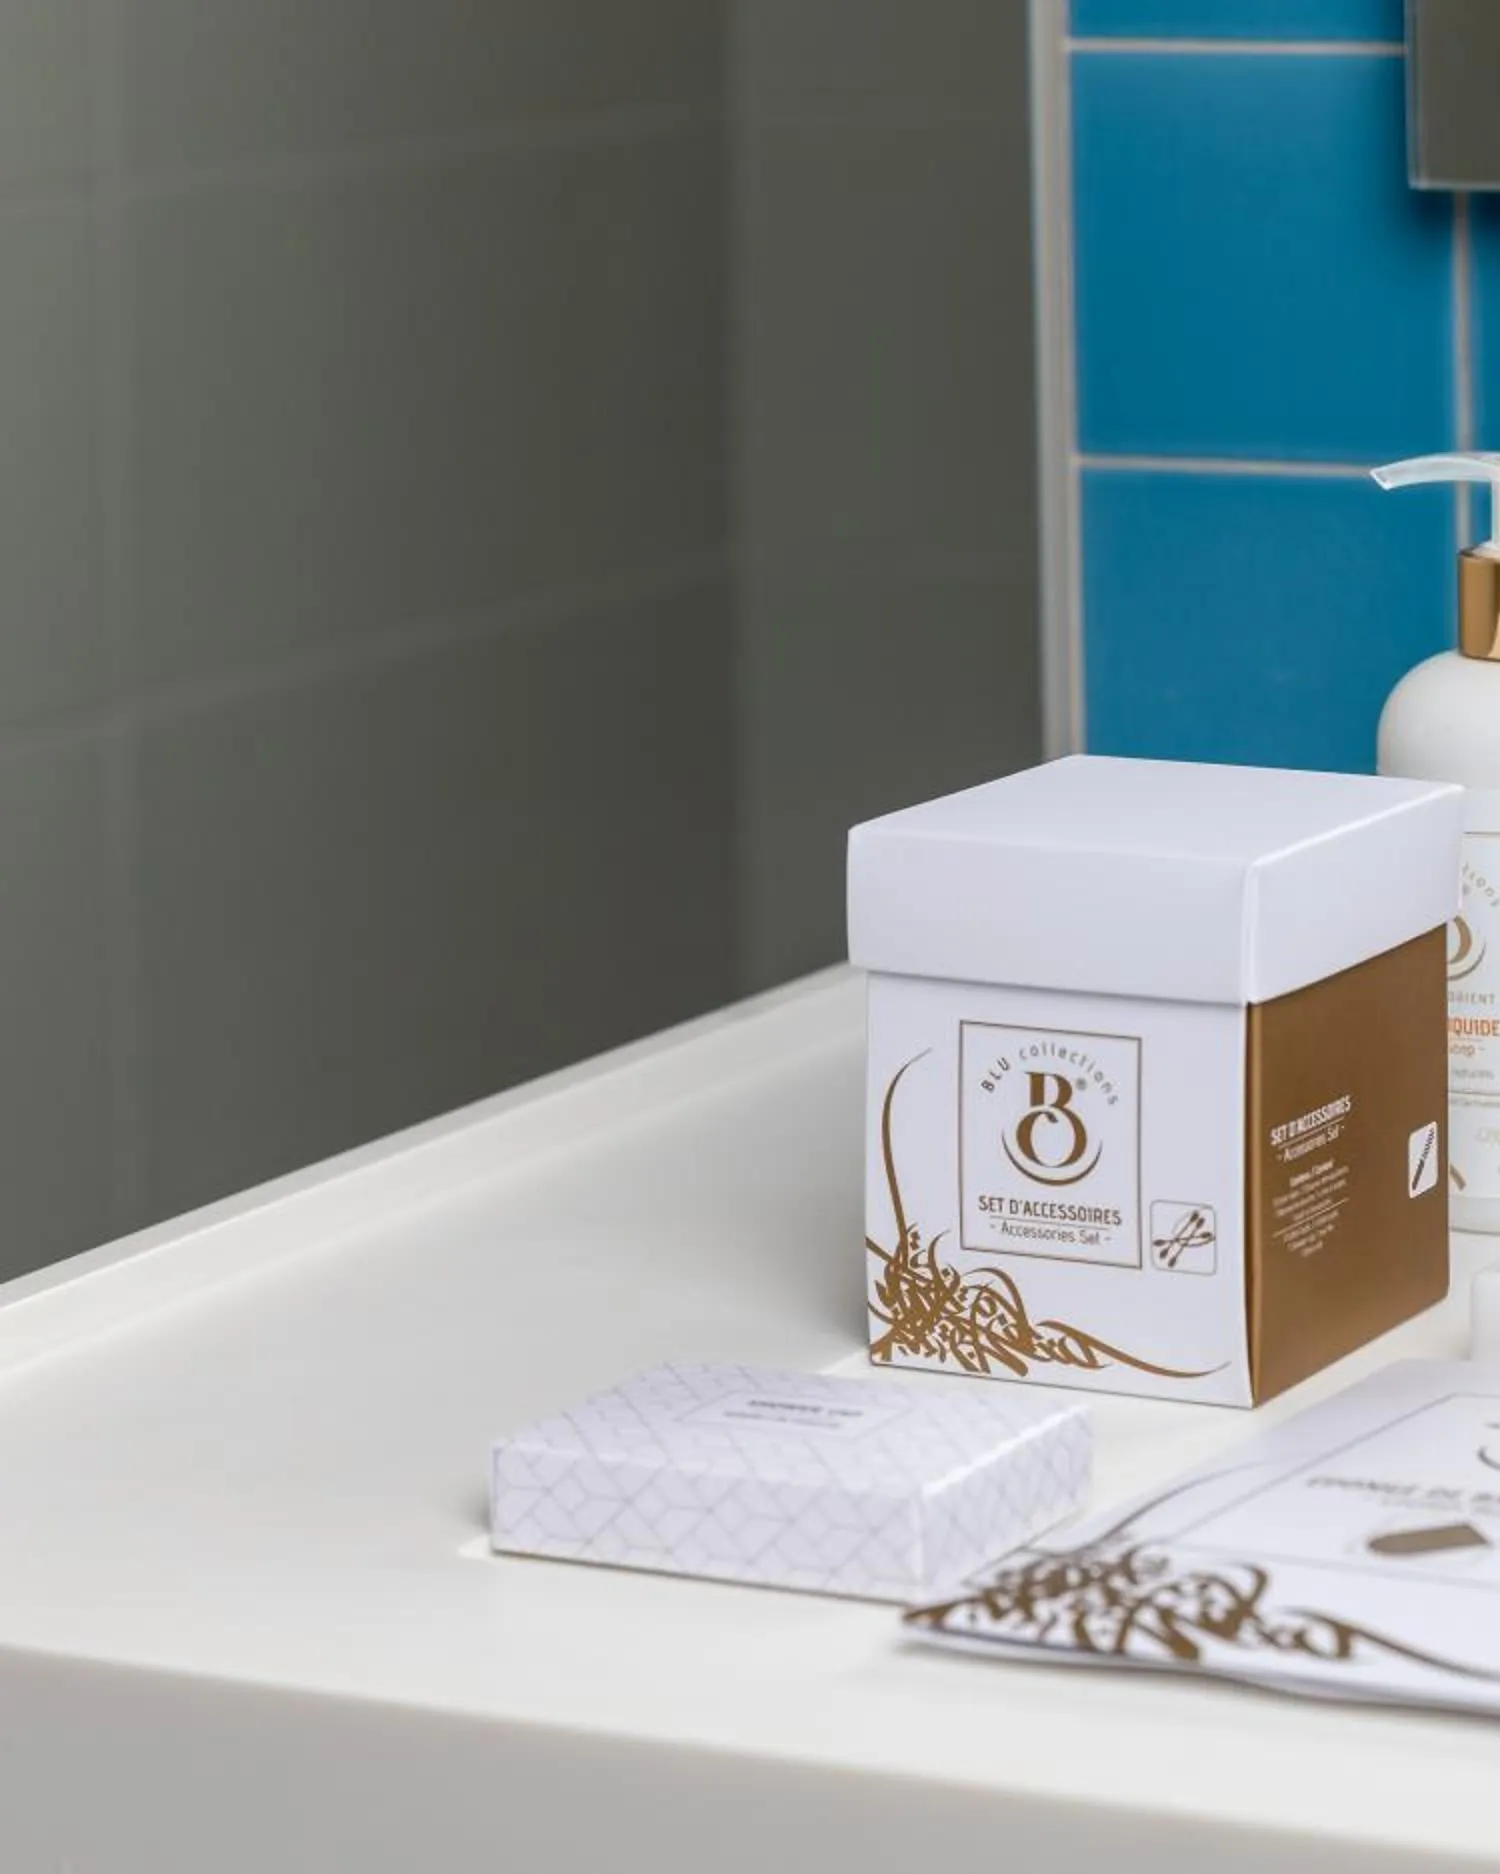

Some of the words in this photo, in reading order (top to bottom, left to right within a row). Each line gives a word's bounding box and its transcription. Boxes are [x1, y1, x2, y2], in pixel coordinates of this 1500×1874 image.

[980, 1056, 1011, 1094] BLU
[1018, 1040, 1120, 1106] collections
[978, 1195, 1005, 1213] SET
[1008, 1199, 1122, 1226] D'ACCESSOIRES
[1001, 1220, 1075, 1243] Accessories
[1079, 1230, 1100, 1246] Set
